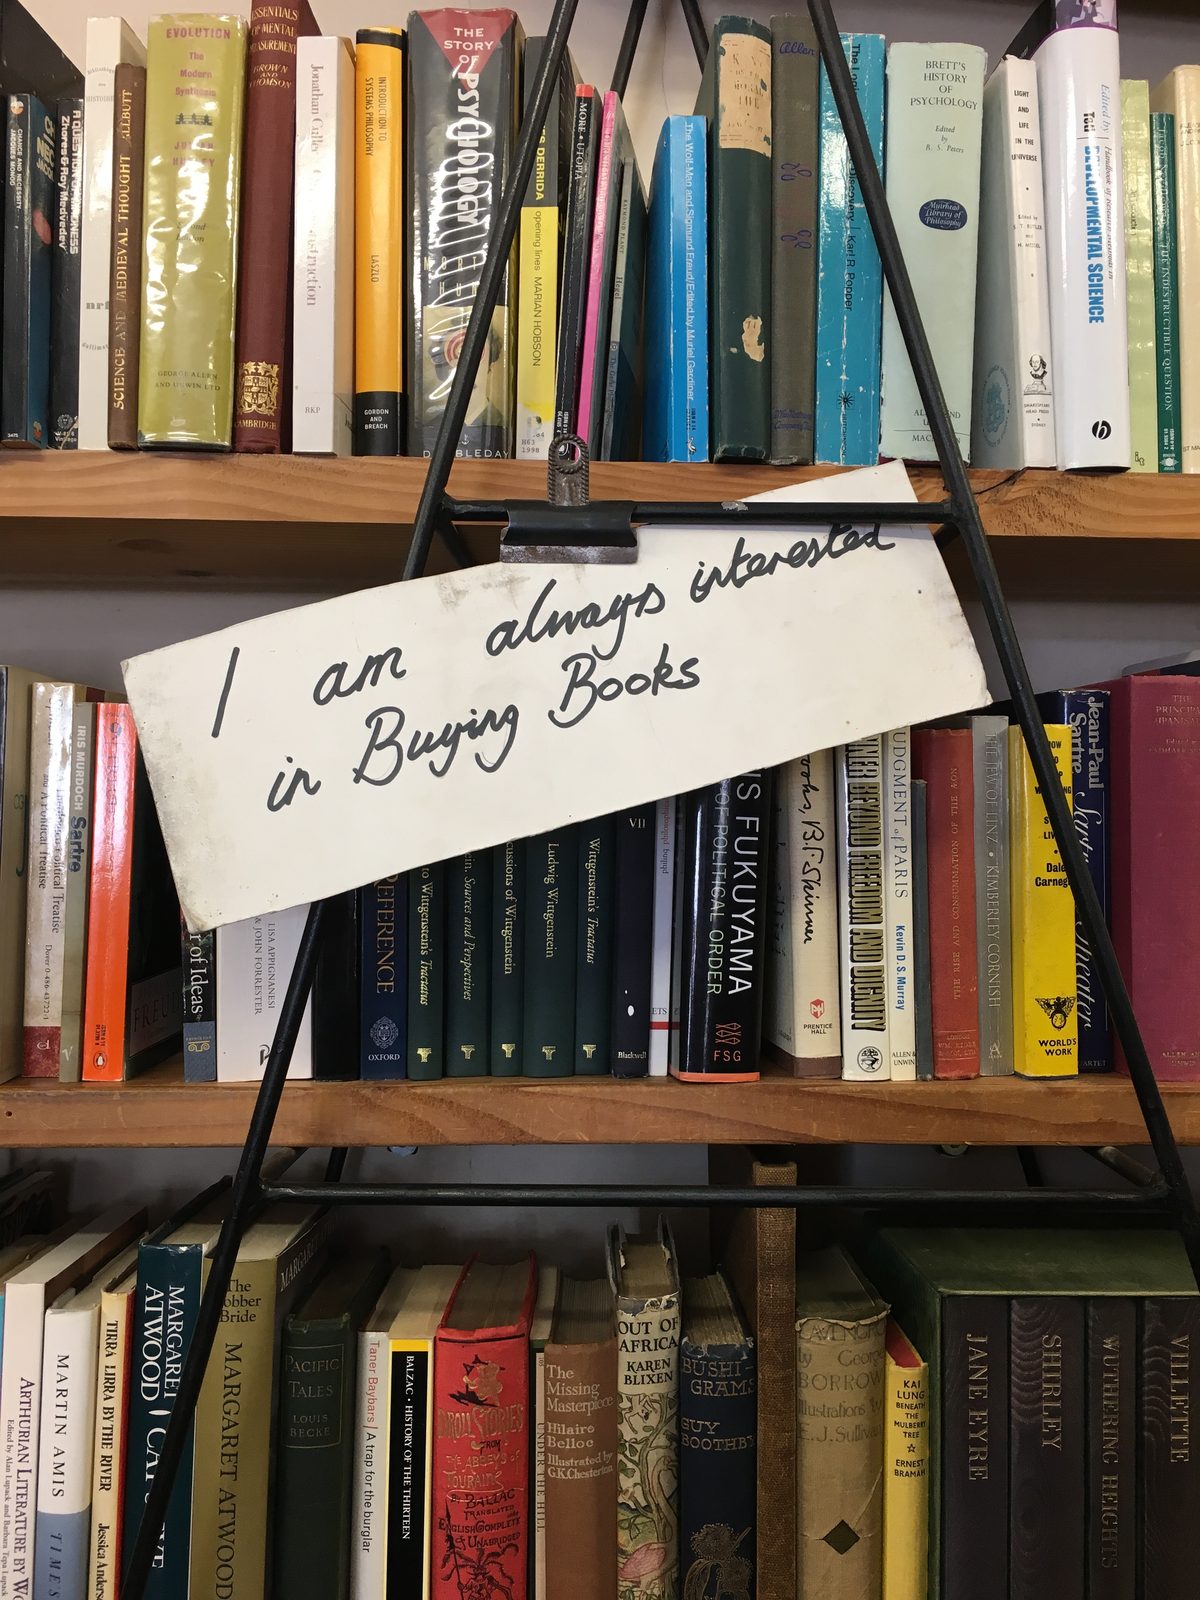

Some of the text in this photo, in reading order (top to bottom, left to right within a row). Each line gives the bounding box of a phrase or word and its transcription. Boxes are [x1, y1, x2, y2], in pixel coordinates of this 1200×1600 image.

[166, 26, 231, 40] EVOLUTION
[454, 28, 484, 38] THE
[444, 40, 494, 50] STORY
[188, 52, 204, 61] The
[458, 54, 480, 64] OF
[850, 44, 861, 66] The
[180, 69, 212, 79] Modern
[925, 60, 966, 72] BRETT'S
[924, 73, 968, 84] HISTORY
[311, 64, 324, 114] Jonathan
[938, 85, 953, 94] OF
[1014, 90, 1030, 98] LIGHT
[378, 76, 386, 142] INTRODUCTION TO
[910, 97, 978, 110] PSYCHOLOGY
[1018, 106, 1030, 114] AND
[366, 77, 374, 156] SYSTEMS PHILOSOPHY
[936, 125, 956, 133] Edited
[457, 72, 480, 223] PSYCHOLOGY
[574, 102, 588, 180] MORE UTOPIA
[941, 135, 948, 144] by
[1012, 154, 1038, 162] UNIVERSE
[536, 147, 545, 200] DERRIDA
[924, 216, 962, 228] Philosophy
[371, 255, 380, 283] LASZLO
[114, 154, 131, 410] SCIENCE AND MEDIEVAL THOUGHT
[532, 210, 543, 368] opening lines MARIAN HOBSON
[191, 372, 218, 380] ALLEN
[364, 408, 389, 416] GORDON
[312, 647, 406, 706] am
[486, 578, 666, 660] always
[690, 522, 896, 603] interested
[266, 644, 700, 812] in Buying Books
[1070, 712, 1086, 774] Sartre
[1087, 696, 1104, 789] Jean-Paul
[68, 724, 86, 873] IRIS MURDOCH Sartre
[629, 818, 646, 829] VII
[891, 828, 908, 899] of PARIS
[542, 842, 560, 958] Ludwig Wittgenstein
[584, 838, 600, 964] Wittgenstein's Tractatus
[706, 793, 730, 994] OF POLITICAL ORDER
[51, 893, 64, 934] Treatise
[728, 816, 760, 995] FUKUYAMA
[848, 782, 886, 1032] BEYOND FREEDOM AND DIGNITY
[418, 882, 434, 956] Wittgenstein's
[460, 878, 476, 1001] Sources and Perspectives
[501, 888, 518, 974] of Wittgenstein
[268, 923, 276, 1009] LISA APPIGNANESI
[190, 946, 208, 1014] of Ideas
[420, 960, 432, 1006] Tractatus
[1038, 1038, 1077, 1047] WORLD'S
[1045, 1048, 1072, 1056] WORK
[368, 1053, 400, 1061] OXFORD
[618, 1051, 647, 1060] Blackwell
[892, 1050, 911, 1058] ALLEN
[219, 1310, 256, 1324] Bride
[618, 1316, 678, 1336] OUT OF
[140, 1283, 164, 1401] ATWOOD
[164, 1285, 186, 1399] MARGARET
[619, 1336, 678, 1353] AFRICA
[368, 1340, 380, 1374] Taner
[626, 1358, 671, 1374] KAREN
[546, 1364, 574, 1379] The
[624, 1371, 673, 1386] BLIXEN
[288, 1380, 334, 1399] TALES
[546, 1382, 600, 1398] Missing
[903, 1380, 922, 1388] KAI
[1041, 1333, 1064, 1451] SHIRLEY
[897, 1390, 926, 1400] LUNG
[1170, 1334, 1191, 1463] VILLETTE
[98, 1320, 118, 1492] TIRRA LIRRA BY THE RIVER
[546, 1396, 614, 1416] Masterpiece
[896, 1402, 926, 1410] BENEATH
[966, 1332, 990, 1480] JANE EYRE
[293, 1414, 328, 1424] LOUIS
[681, 1416, 720, 1435] GUY
[894, 1420, 927, 1428] MULBERRY
[904, 1412, 920, 1420] THE
[52, 1354, 70, 1498] MARTIN AMIS
[290, 1427, 330, 1438] BECKE
[547, 1422, 594, 1436] Hilaire
[402, 1355, 415, 1540] BALZAC HISTORY OF THE THIRTEEN
[547, 1436, 594, 1449] Belloc
[364, 1444, 377, 1468] trap
[547, 1450, 613, 1467] Illustrated by
[1100, 1336, 1121, 1569] WUTHERING HEIGHTS
[214, 1342, 243, 1600] MARGARET ATWOOD
[896, 1458, 924, 1468] ERNEST
[13, 1377, 36, 1574] ARTHURIAN LITERATURE BY
[364, 1471, 376, 1488] for
[894, 1470, 926, 1478] BRAMAH
[363, 1490, 375, 1508] the
[96, 1522, 110, 1560] Jessica
[360, 1511, 374, 1553] burglar
